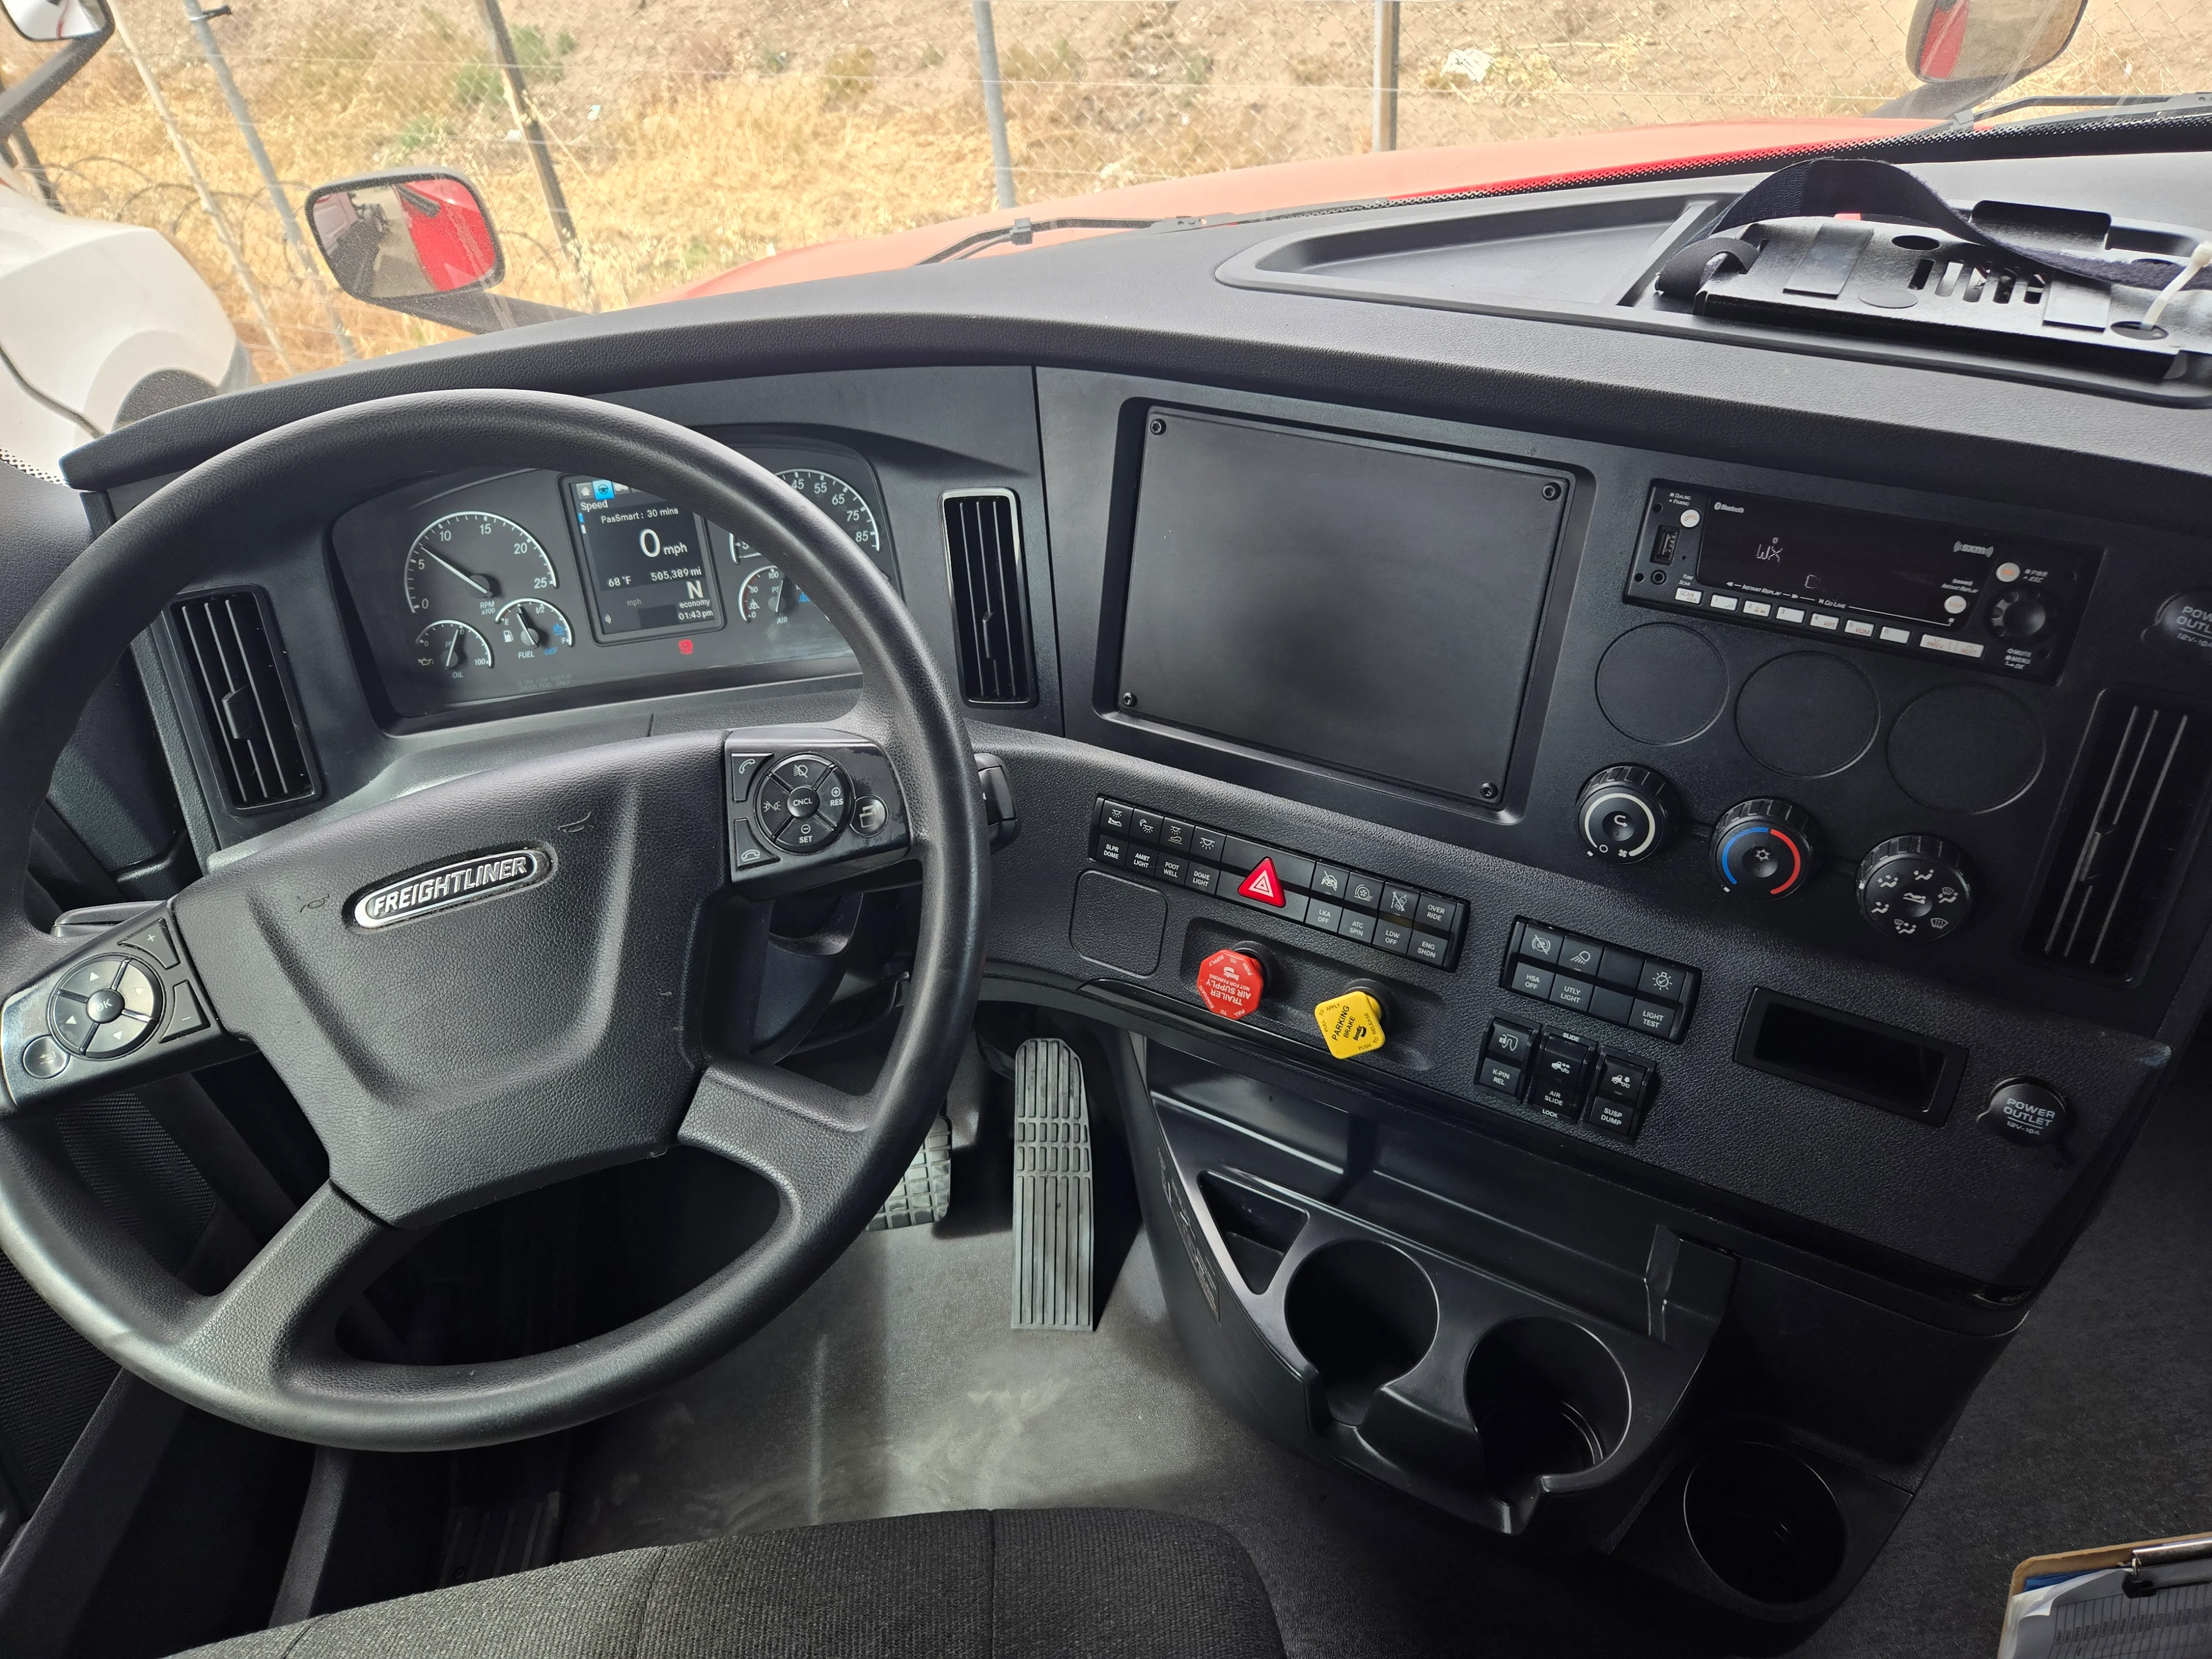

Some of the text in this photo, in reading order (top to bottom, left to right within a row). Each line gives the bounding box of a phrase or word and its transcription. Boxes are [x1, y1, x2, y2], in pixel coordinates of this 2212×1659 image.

[791, 479, 805, 490] 45
[814, 482, 827, 494] 55
[832, 494, 845, 505] 65
[581, 499, 608, 512] Speed
[1720, 504, 1745, 514] Bluetooth
[647, 509, 658, 518] 30
[660, 507, 679, 517] mins
[847, 510, 860, 522] 75
[479, 524, 492, 534] 15
[440, 531, 452, 541] 10
[855, 530, 869, 542] 85
[639, 528, 688, 557] 0 mph
[514, 542, 528, 554] 20
[418, 560, 425, 570] 5
[651, 566, 702, 581] 505,389 mi
[534, 578, 547, 589] 25
[608, 577, 620, 588] 68
[686, 580, 703, 599] N
[421, 598, 429, 609] 0
[627, 598, 642, 607] mph
[679, 599, 711, 609] economy
[679, 609, 714, 620] 01:43 pm
[1855, 627, 1870, 635] RDM
[2011, 656, 2031, 664] MENU
[792, 798, 813, 806] CNCL
[830, 798, 844, 806] RES
[1105, 843, 1119, 853] SLPR
[1103, 849, 1119, 859] DOME
[1135, 853, 1150, 862] AMBT
[1133, 859, 1149, 868] LIGHT
[1165, 862, 1180, 870] FOOT
[1164, 868, 1178, 878] WELL
[1193, 870, 1210, 880] DOME
[373, 857, 527, 917] FREIGHTLINER
[1192, 877, 1209, 887] LIGHT
[1319, 909, 1331, 918] LKA
[1427, 904, 1446, 915] OVER
[1317, 916, 1329, 924] OFF
[1427, 912, 1442, 921] RIDE
[1352, 920, 1364, 929] ATC
[1349, 927, 1363, 936] SPIN
[1385, 930, 1400, 939] LDW
[1385, 936, 1398, 946] OFF
[1422, 941, 1435, 951] ENG
[1417, 948, 1436, 958] SHDN
[1209, 955, 1224, 966] SUPPLY
[1242, 962, 1252, 975] PUSH
[1209, 974, 1229, 984] PARKING
[1526, 974, 1540, 983] HSA
[1206, 979, 1251, 999] AIR SUPPLY
[1525, 980, 1538, 990] OFF
[1564, 985, 1581, 996] UTLY
[1198, 985, 1214, 1009] EVACUATE
[1210, 988, 1243, 1006] TRAILER
[1560, 993, 1581, 1003] LIGHT
[95, 998, 113, 1013] OK
[1326, 1003, 1340, 1011] APPLY
[1234, 1009, 1245, 1017] PULL
[1642, 1010, 1664, 1021] LIGHT
[1332, 1005, 1349, 1041] PARKING
[1343, 1016, 1355, 1039] BRAKE
[1364, 1012, 1376, 1035] RELEASE
[1643, 1018, 1660, 1029] TEST
[1353, 1025, 1363, 1041] Bendix
[1562, 1032, 1579, 1042] SLIDE
[1493, 1068, 1510, 1079] K-PIN
[1493, 1076, 1505, 1086] REL
[1549, 1090, 1561, 1099] AIR
[1545, 1095, 1563, 1106] SLIDE
[1542, 1109, 1558, 1118] LOCK
[1603, 1107, 1623, 1118] SUSP
[2006, 1098, 2056, 1119] POWER
[1600, 1114, 1622, 1126] DUMP
[2004, 1106, 2053, 1126] OUTLET
[2006, 1120, 2040, 1136] 12V-10A
